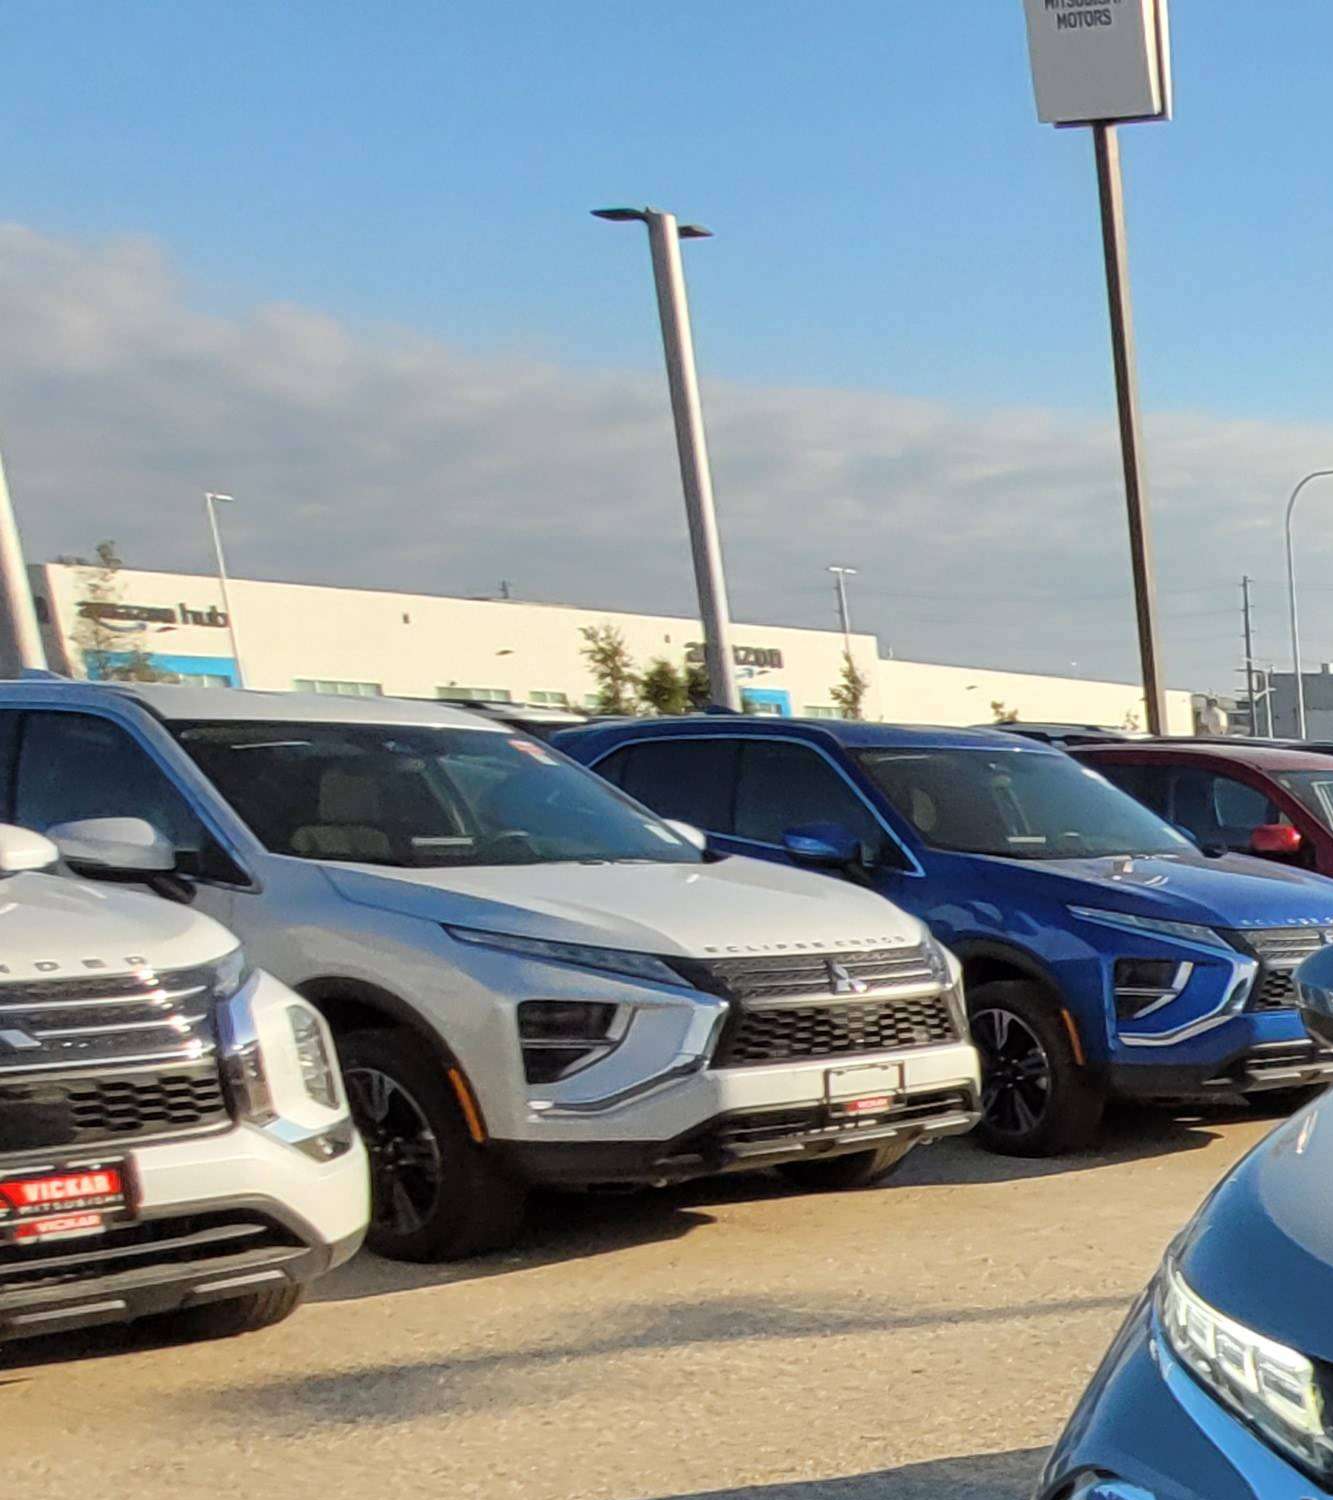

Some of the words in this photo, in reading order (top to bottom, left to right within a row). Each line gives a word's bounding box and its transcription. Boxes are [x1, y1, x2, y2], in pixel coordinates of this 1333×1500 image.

[1057, 9, 1112, 29] MOTORS
[178, 602, 230, 628] hub
[23, 1175, 110, 1202] VICKAR
